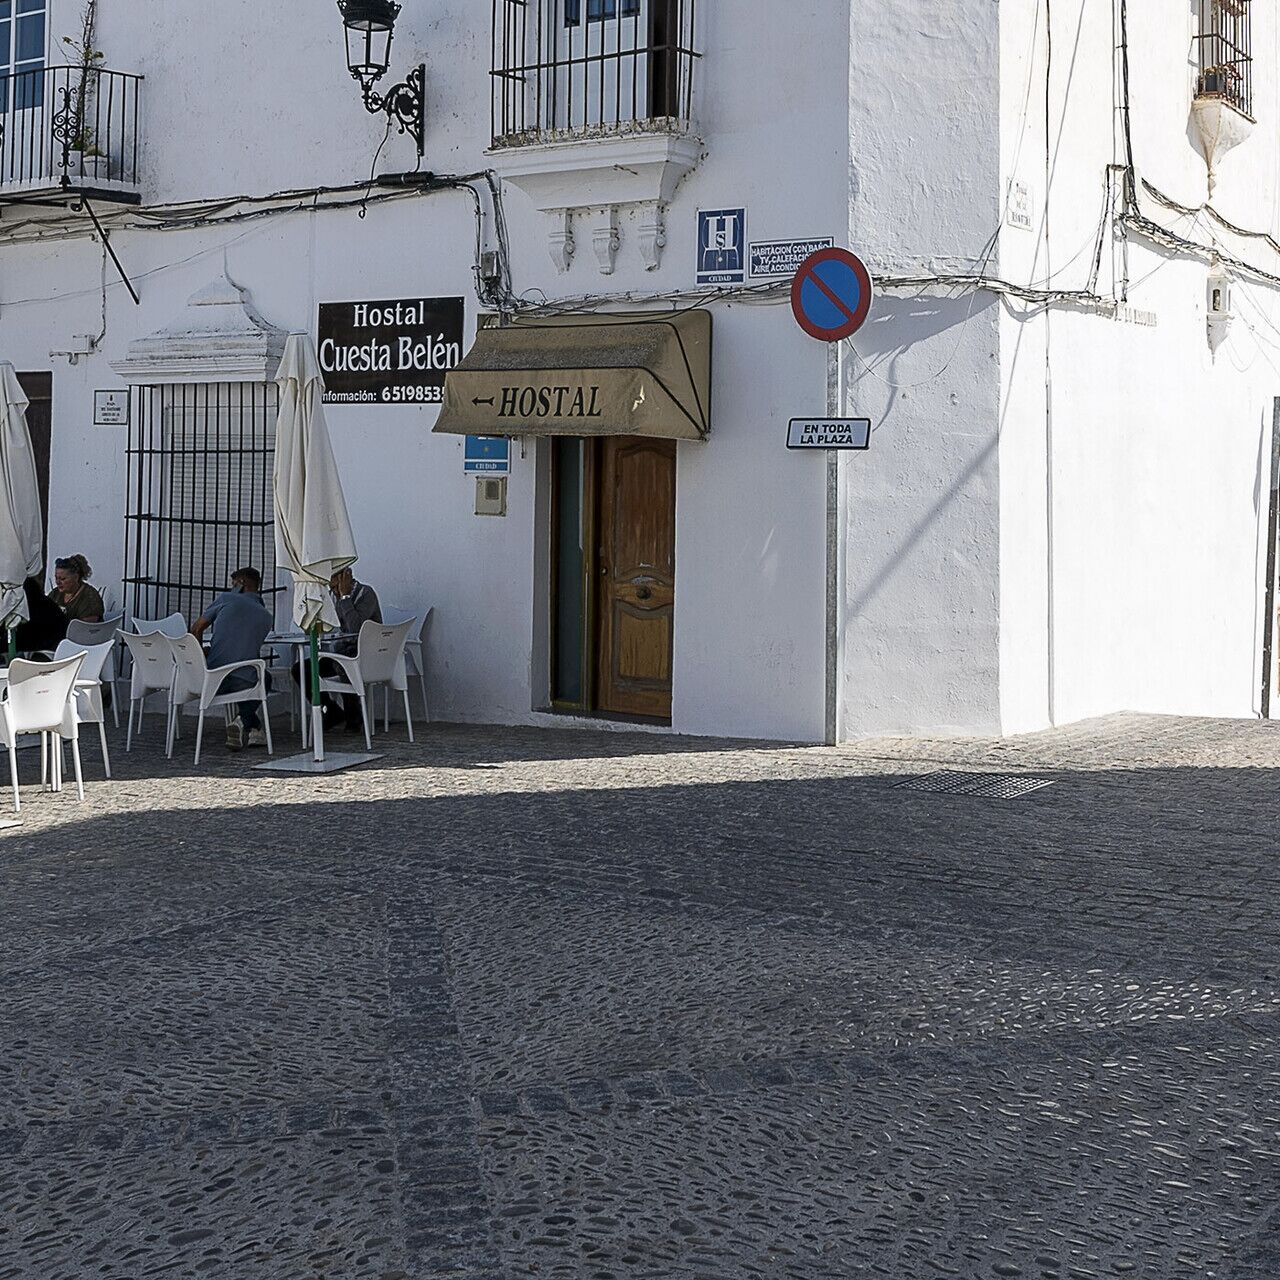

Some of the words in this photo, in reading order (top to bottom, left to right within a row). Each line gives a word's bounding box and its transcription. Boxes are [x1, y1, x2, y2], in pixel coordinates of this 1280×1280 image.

[792, 244, 808, 253] CON
[753, 264, 770, 273] AIRE
[708, 275, 732, 283] CIUDAD
[353, 301, 425, 327] Hostal
[320, 337, 391, 372] Cuesta
[397, 333, 460, 370] Belén
[322, 390, 377, 402] nformación:
[497, 386, 602, 417] HOSTAL
[804, 424, 819, 434] EN
[822, 424, 852, 434] TODA
[800, 435, 814, 444] LA
[817, 435, 853, 444] PLAZA
